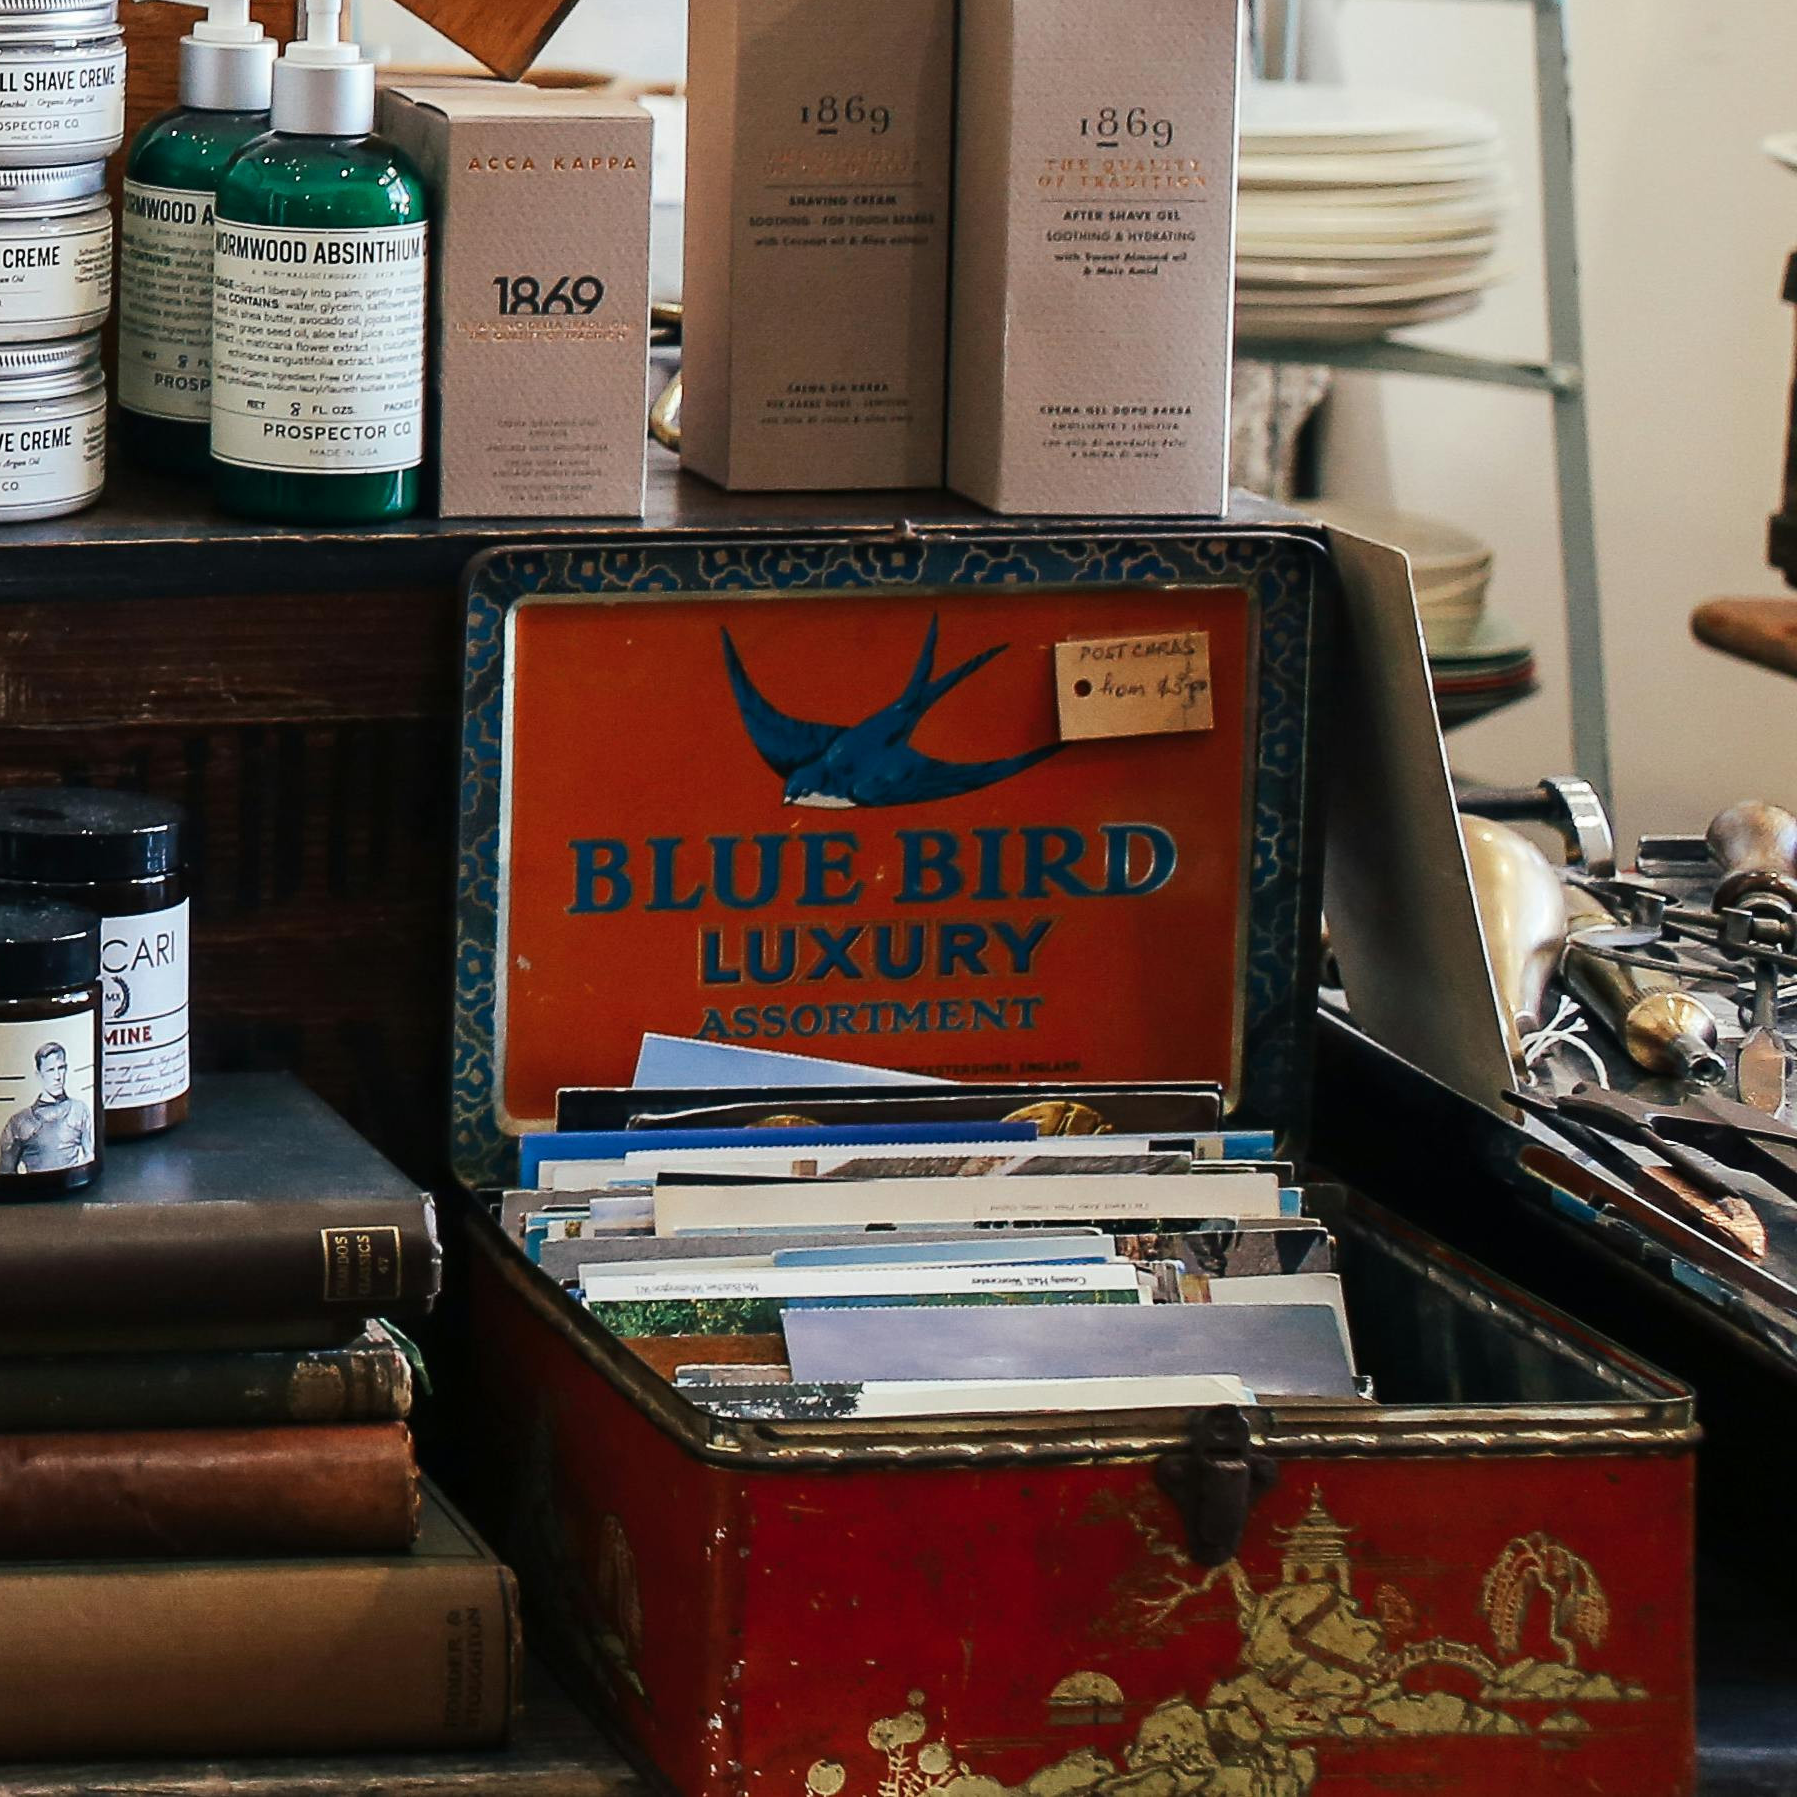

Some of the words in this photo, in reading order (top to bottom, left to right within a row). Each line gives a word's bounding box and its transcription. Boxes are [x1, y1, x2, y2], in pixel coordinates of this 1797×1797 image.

[24, 69, 74, 92] SHAVE
[80, 65, 115, 87] CREME
[799, 94, 892, 136] 1869
[1079, 106, 1174, 148] 1869
[468, 157, 536, 171] ACCA
[553, 156, 637, 171] KAPPA
[1063, 211, 1103, 222] AFTER
[1109, 211, 1151, 222] SHAVE
[1157, 210, 1181, 221] GEL
[3, 245, 60, 269] CREME
[313, 236, 420, 264] ABSINTHIUM
[493, 274, 605, 316] 1869
[299, 315, 344, 325] avocado
[312, 330, 335, 339] aloe
[290, 402, 301, 416] 8
[21, 426, 72, 452] CREME
[263, 422, 386, 440] PROSPECTOR
[566, 830, 866, 915] BLUE
[895, 822, 1178, 904] BIRD
[698, 914, 1057, 986] LUXURY
[694, 994, 1045, 1041] ASSORTMENT
